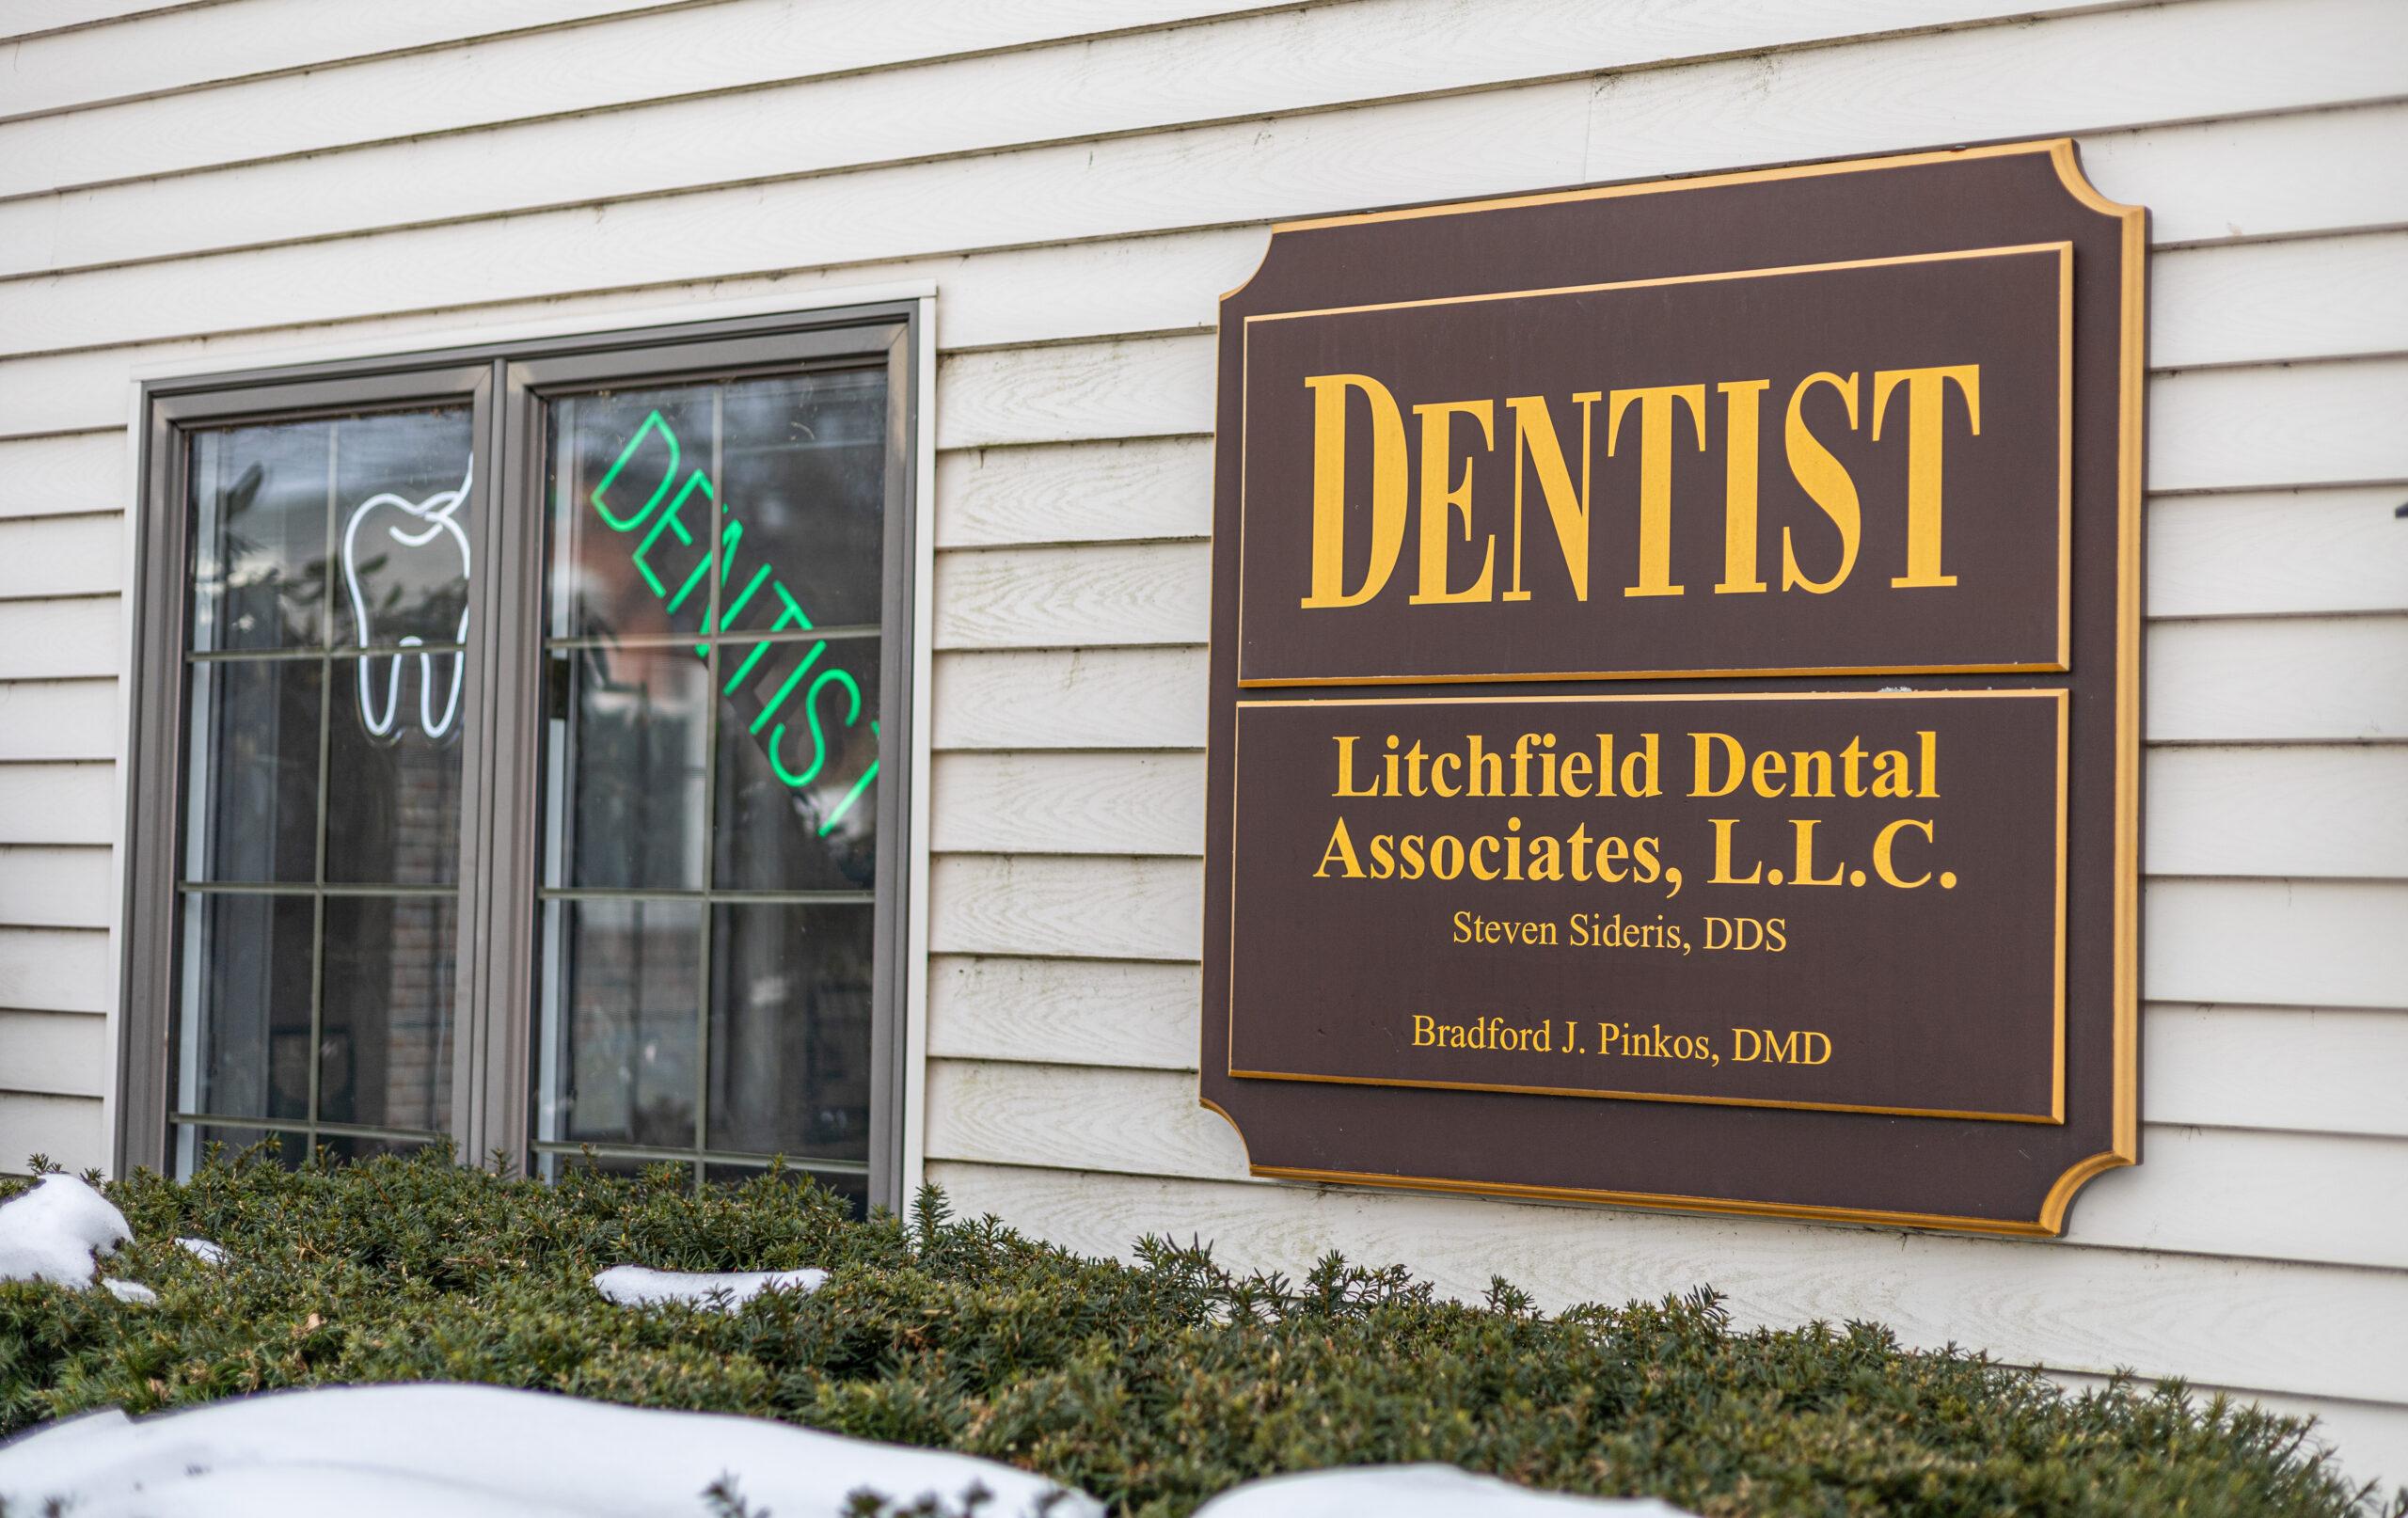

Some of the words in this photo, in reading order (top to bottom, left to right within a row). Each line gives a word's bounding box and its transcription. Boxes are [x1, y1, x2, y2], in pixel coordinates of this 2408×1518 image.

[1299, 363, 1981, 609] DENTIST
[1331, 732, 1662, 799] Litchfield
[1686, 730, 1940, 799] Dental
[1312, 815, 1683, 899] Associates,
[1706, 818, 1958, 890] L.L.C.
[1452, 909, 1558, 946] Steven
[1569, 912, 1692, 955] Sideris,
[1703, 916, 1787, 953] DDS
[1413, 1013, 1552, 1052] Bradford
[1561, 1020, 1587, 1055] J.
[1598, 1022, 1721, 1067] Pinkos,
[1731, 1028, 1833, 1066] DMD
